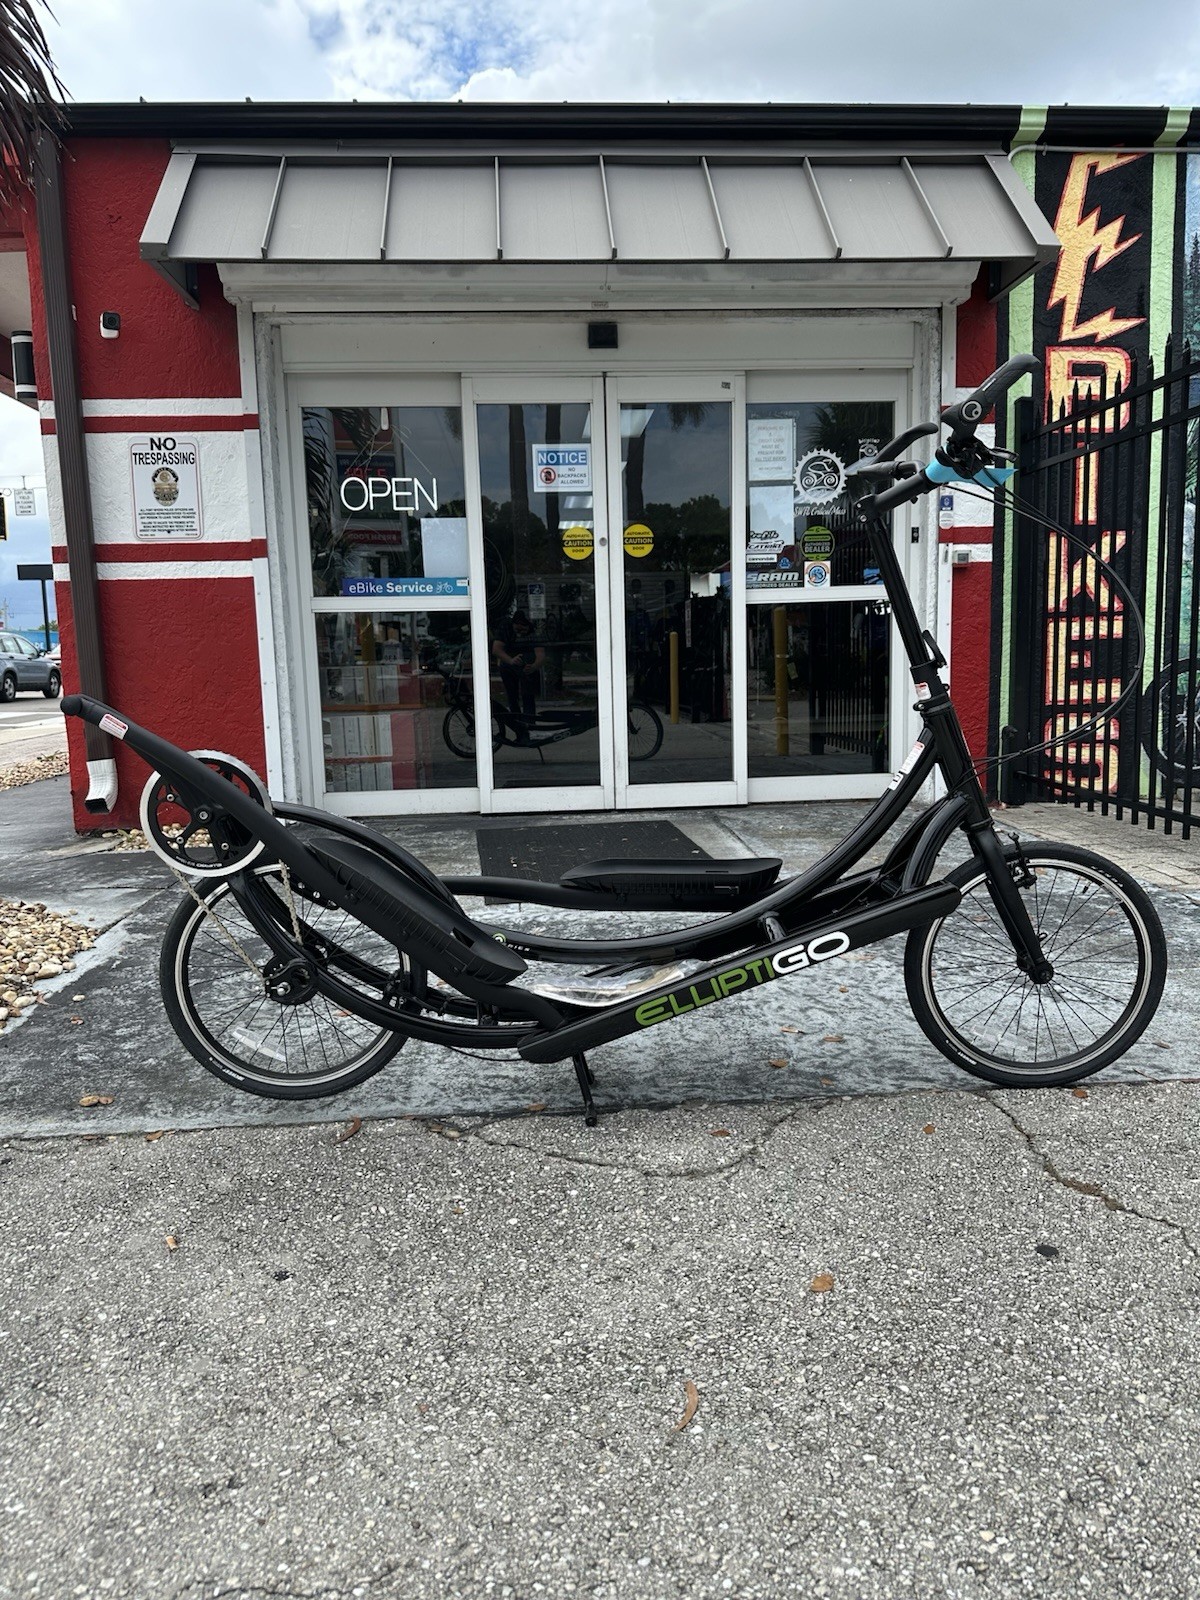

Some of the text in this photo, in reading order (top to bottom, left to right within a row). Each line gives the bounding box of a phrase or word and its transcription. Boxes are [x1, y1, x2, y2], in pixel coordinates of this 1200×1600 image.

[150, 437, 177, 451] NO
[132, 452, 195, 465] TRESPASSING
[538, 452, 587, 464] NOTICE
[340, 476, 438, 511] OPEN
[746, 572, 799, 581] SRAM
[349, 582, 433, 594] eBike Service
[635, 930, 851, 1027] ELLIPTIGO
